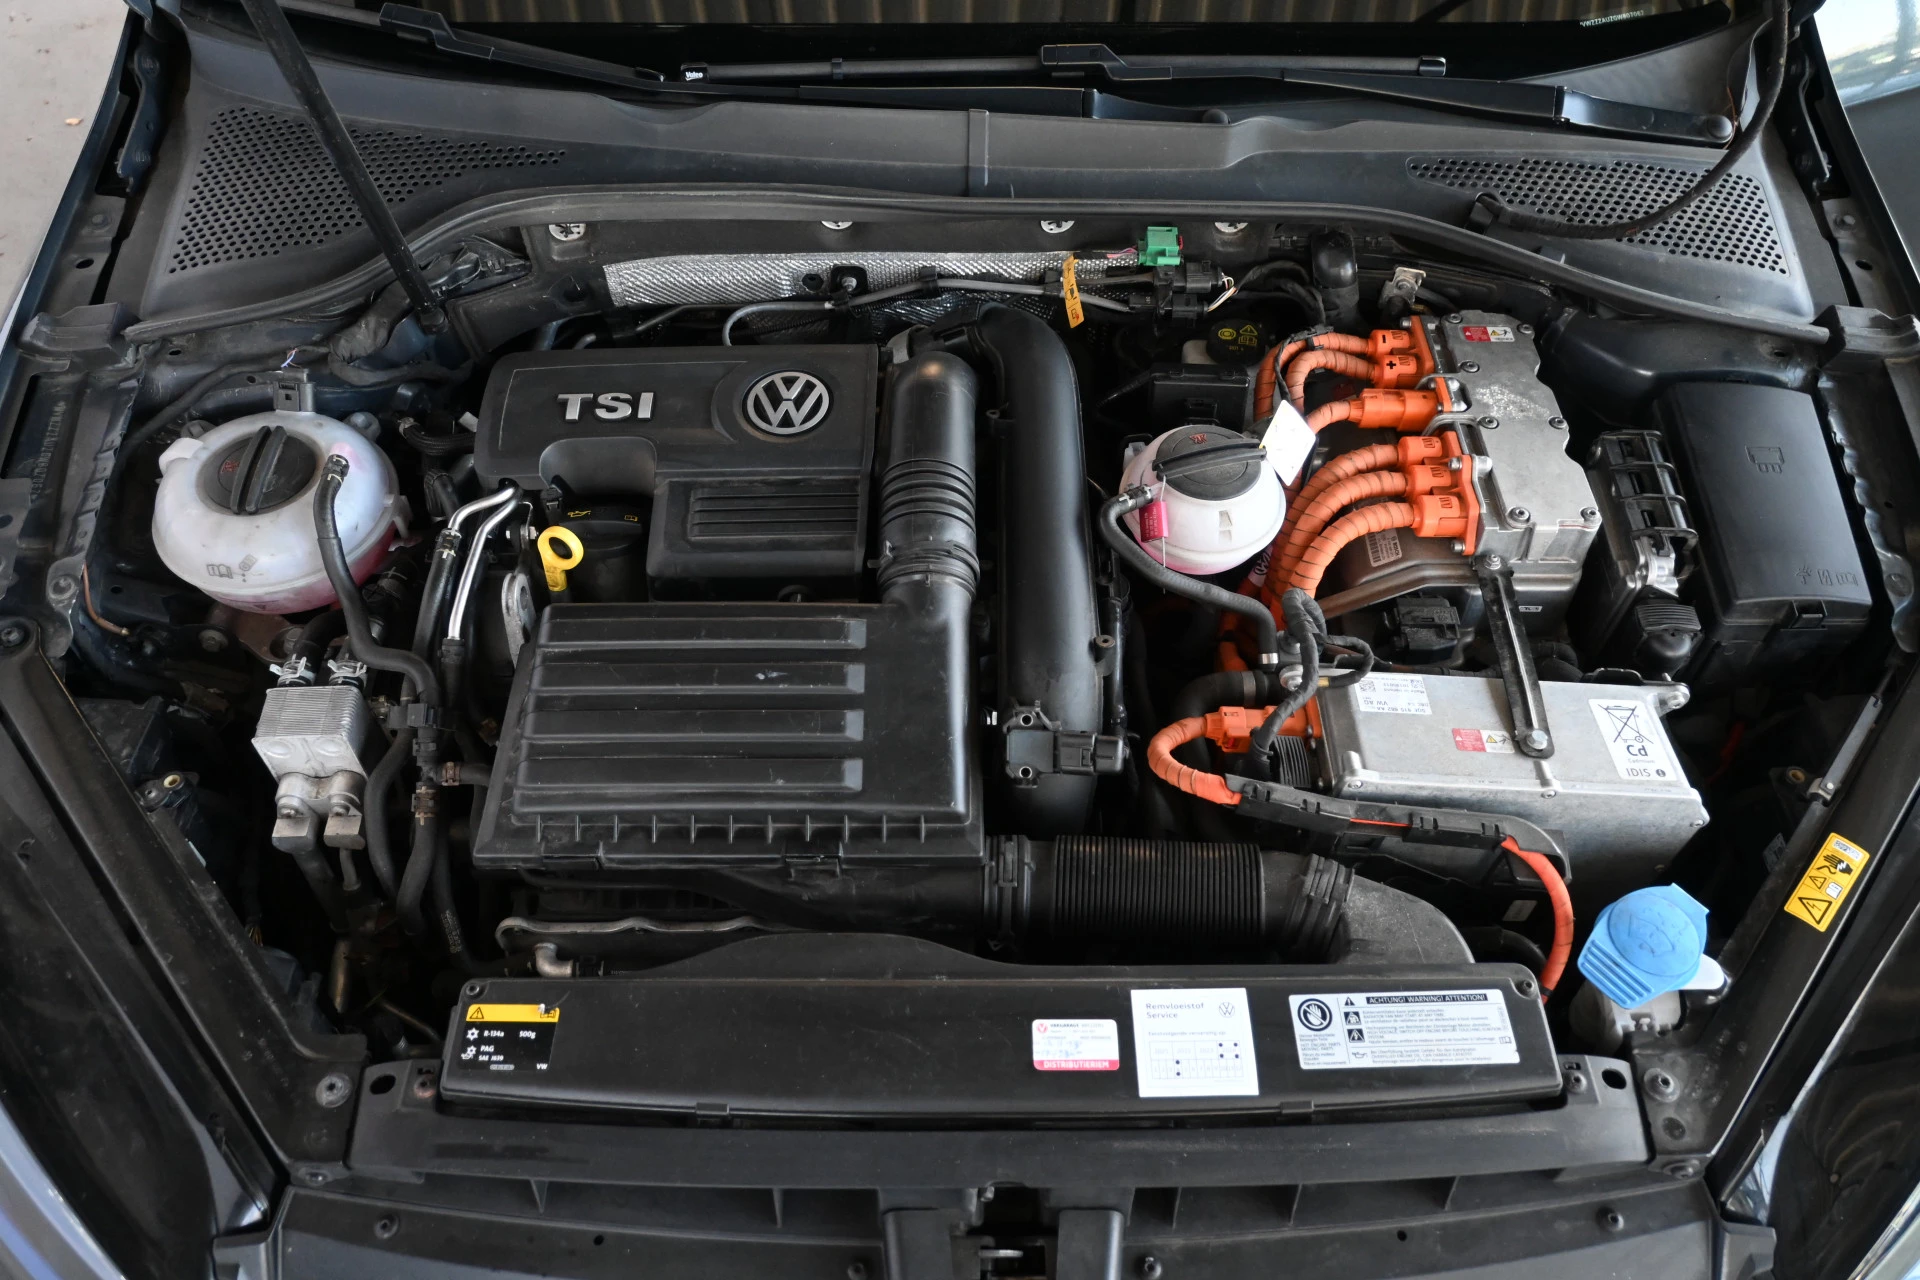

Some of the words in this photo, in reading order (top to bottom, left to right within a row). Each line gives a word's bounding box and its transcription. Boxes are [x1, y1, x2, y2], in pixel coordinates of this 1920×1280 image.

[685, 71, 703, 79] Valeo
[557, 392, 654, 421] TSI
[747, 371, 829, 434] VW
[1626, 744, 1648, 756] Cd
[1626, 768, 1651, 777] IDIS
[1145, 1002, 1204, 1010] Remvloeistof
[519, 1030, 536, 1039] 500g
